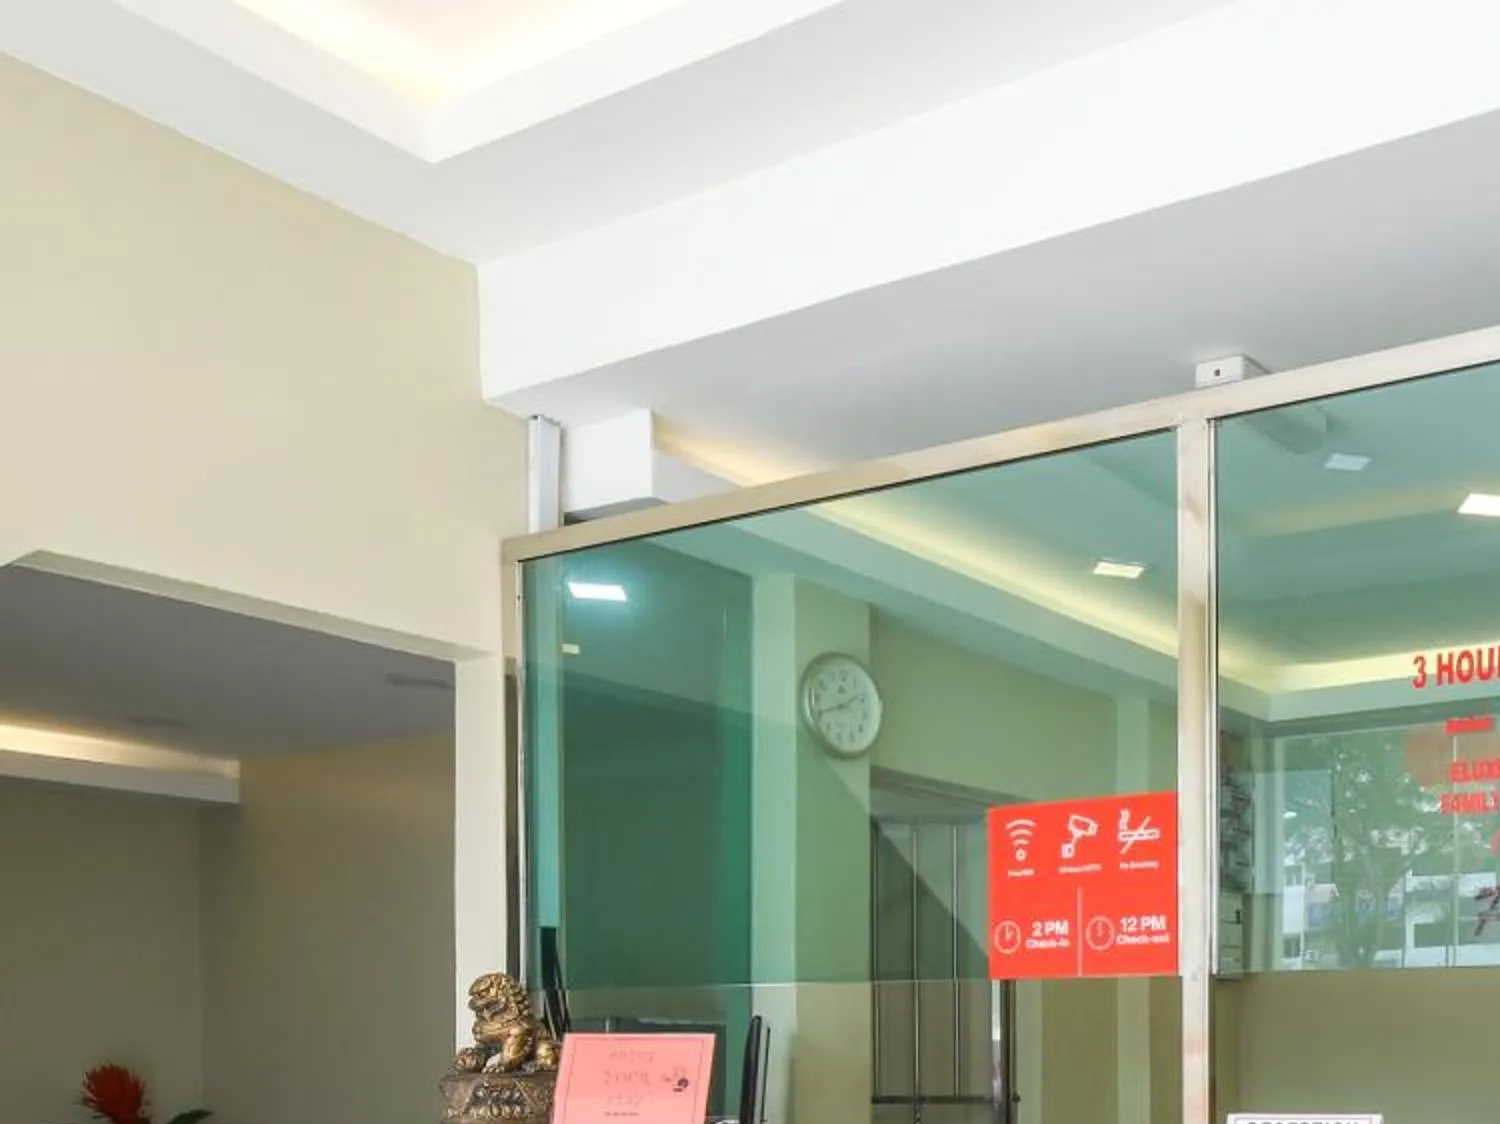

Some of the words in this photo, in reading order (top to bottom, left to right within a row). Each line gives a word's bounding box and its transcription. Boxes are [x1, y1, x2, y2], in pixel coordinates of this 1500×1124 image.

[1413, 655, 1427, 688] 3
[1032, 920, 1043, 937] 2
[1044, 919, 1069, 936] PM
[1120, 916, 1138, 933] 12
[1140, 915, 1167, 931] PM
